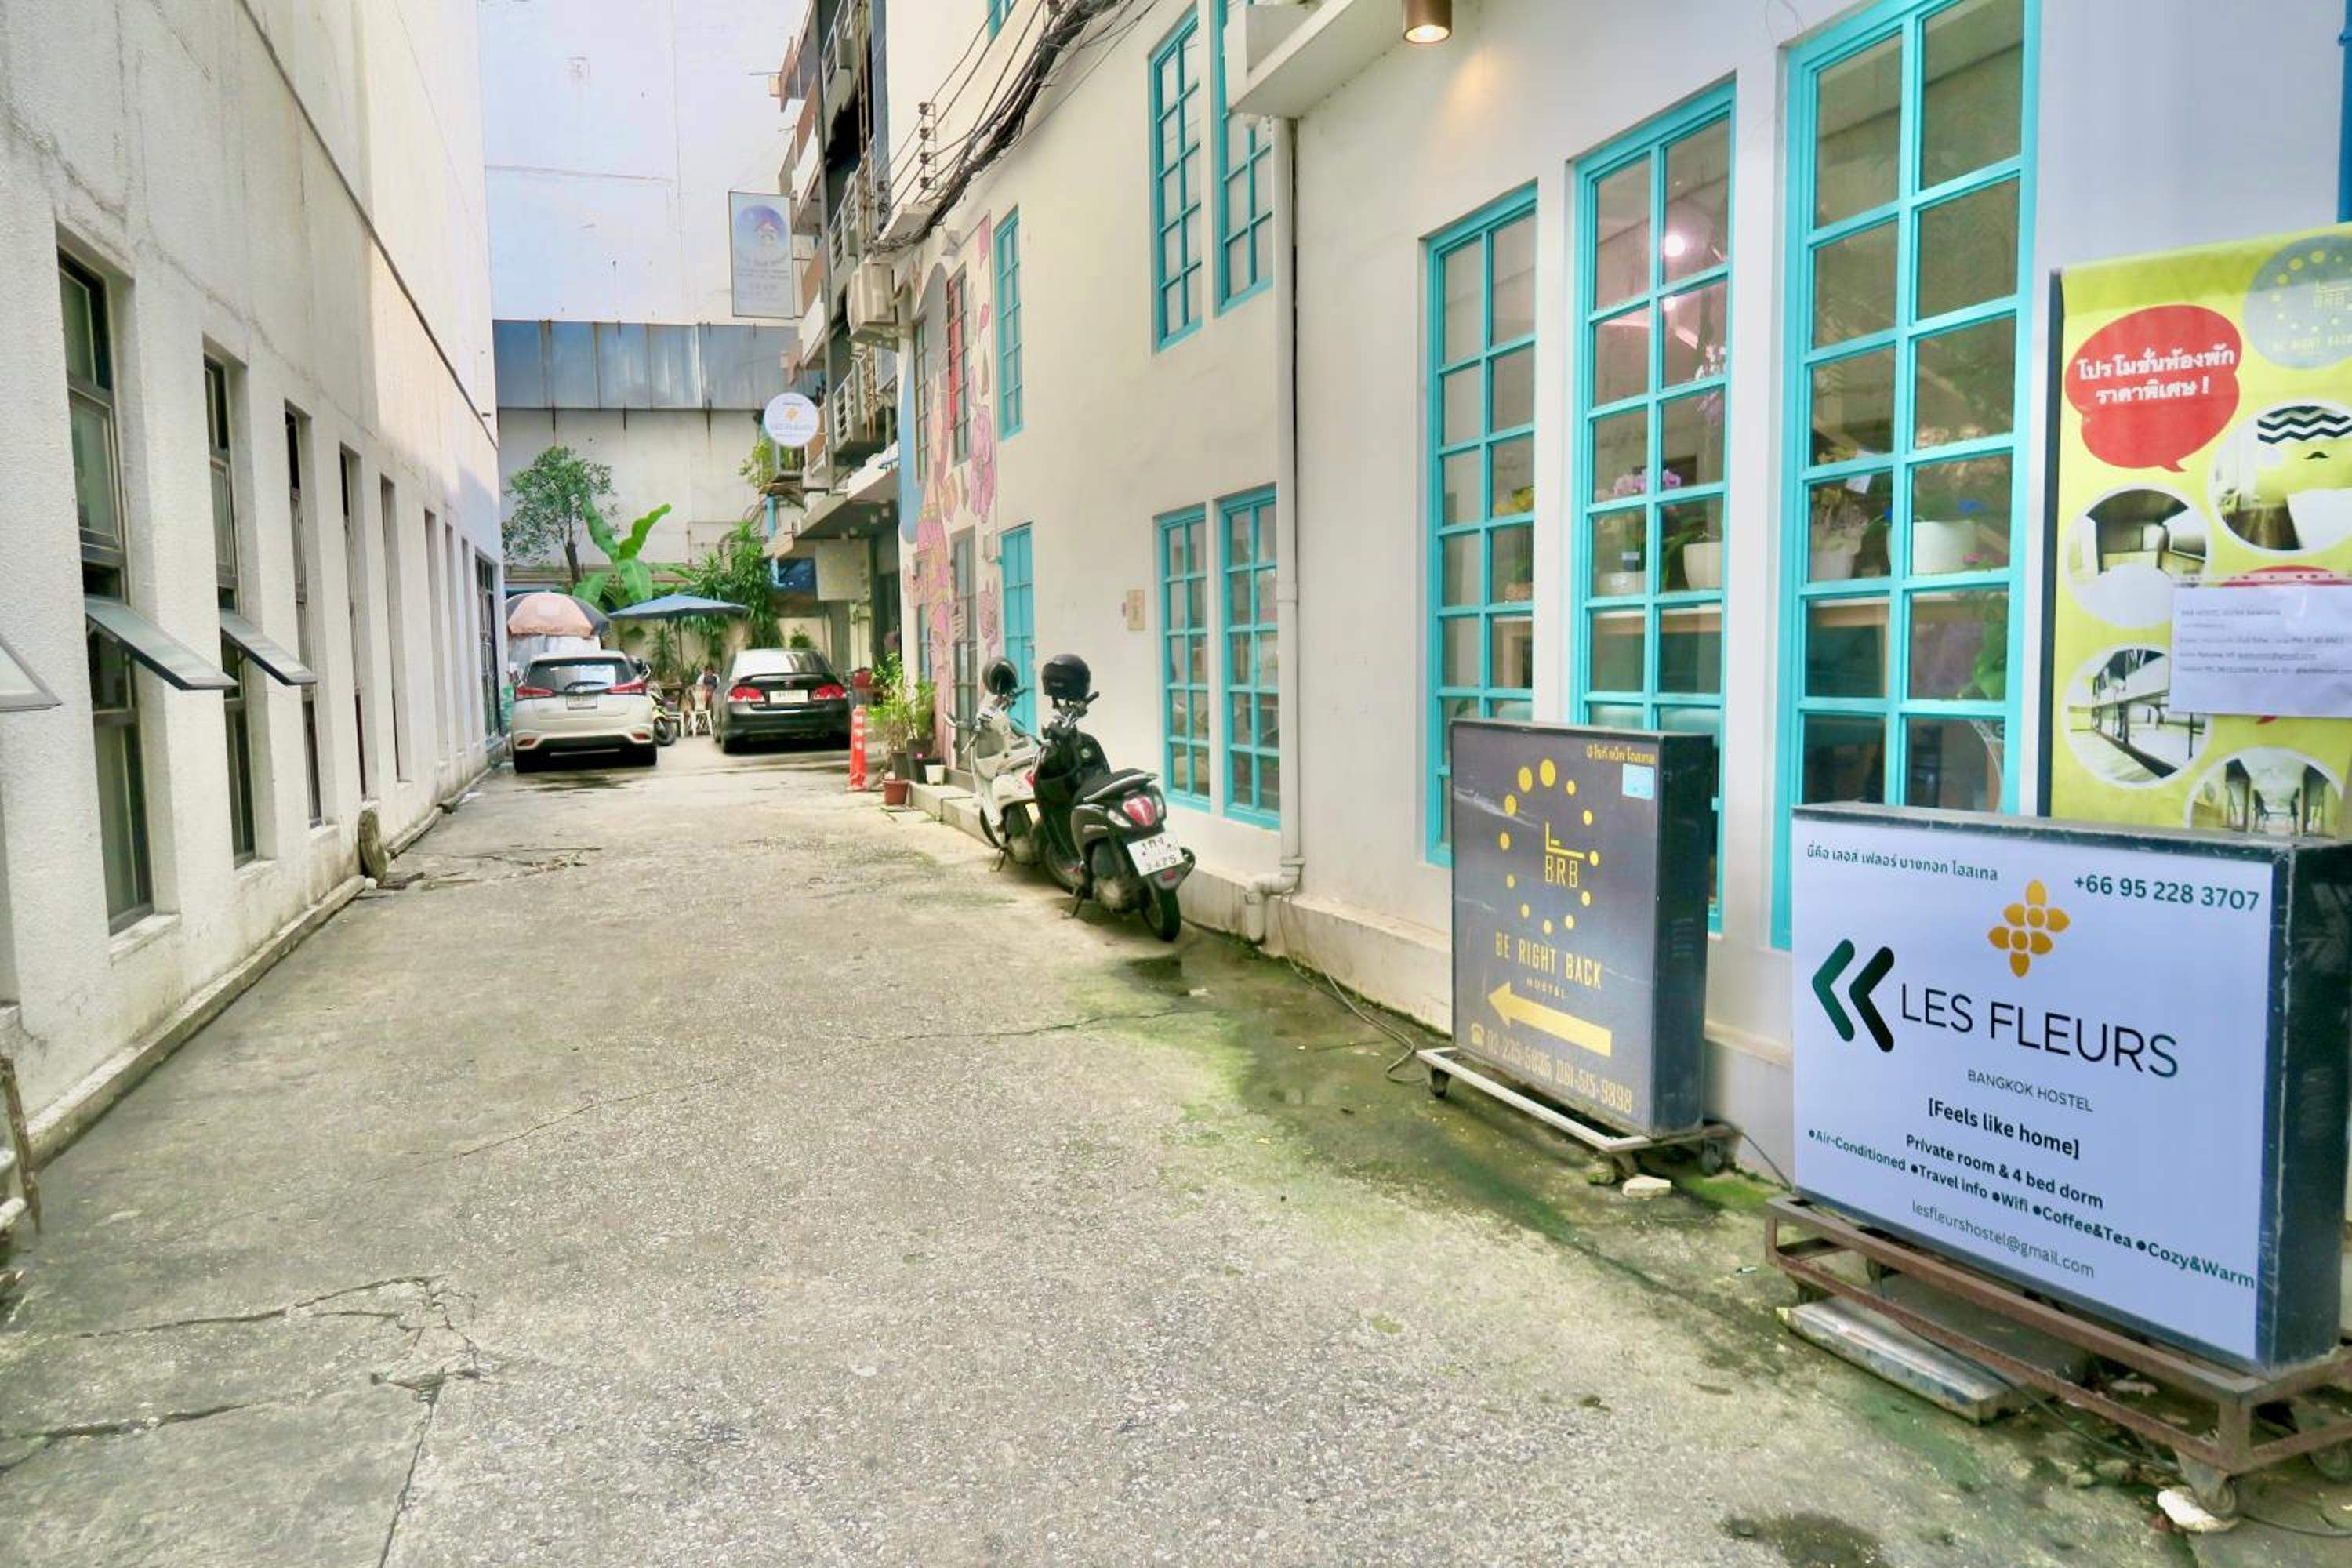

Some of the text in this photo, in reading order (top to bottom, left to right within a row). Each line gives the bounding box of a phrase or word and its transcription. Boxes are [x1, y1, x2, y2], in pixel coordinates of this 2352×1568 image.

[1545, 855, 1578, 888] BRB
[1900, 858, 1948, 873] บางกอก
[2074, 874, 2259, 911] +66 95 228 3707
[1495, 931, 1602, 990] BE RIGHT BACK
[1901, 982, 2178, 1078] LES FLEURS
[1967, 1069, 2093, 1112] BANGKOK HOSTEL
[1928, 1097, 2079, 1160] [Feels like home]
[1906, 1134, 2103, 1209] Private room & 4 bed dorm
[1962, 1178, 1987, 1199] info
[1912, 1200, 2095, 1278] lesfleurshostel@gmail.com
